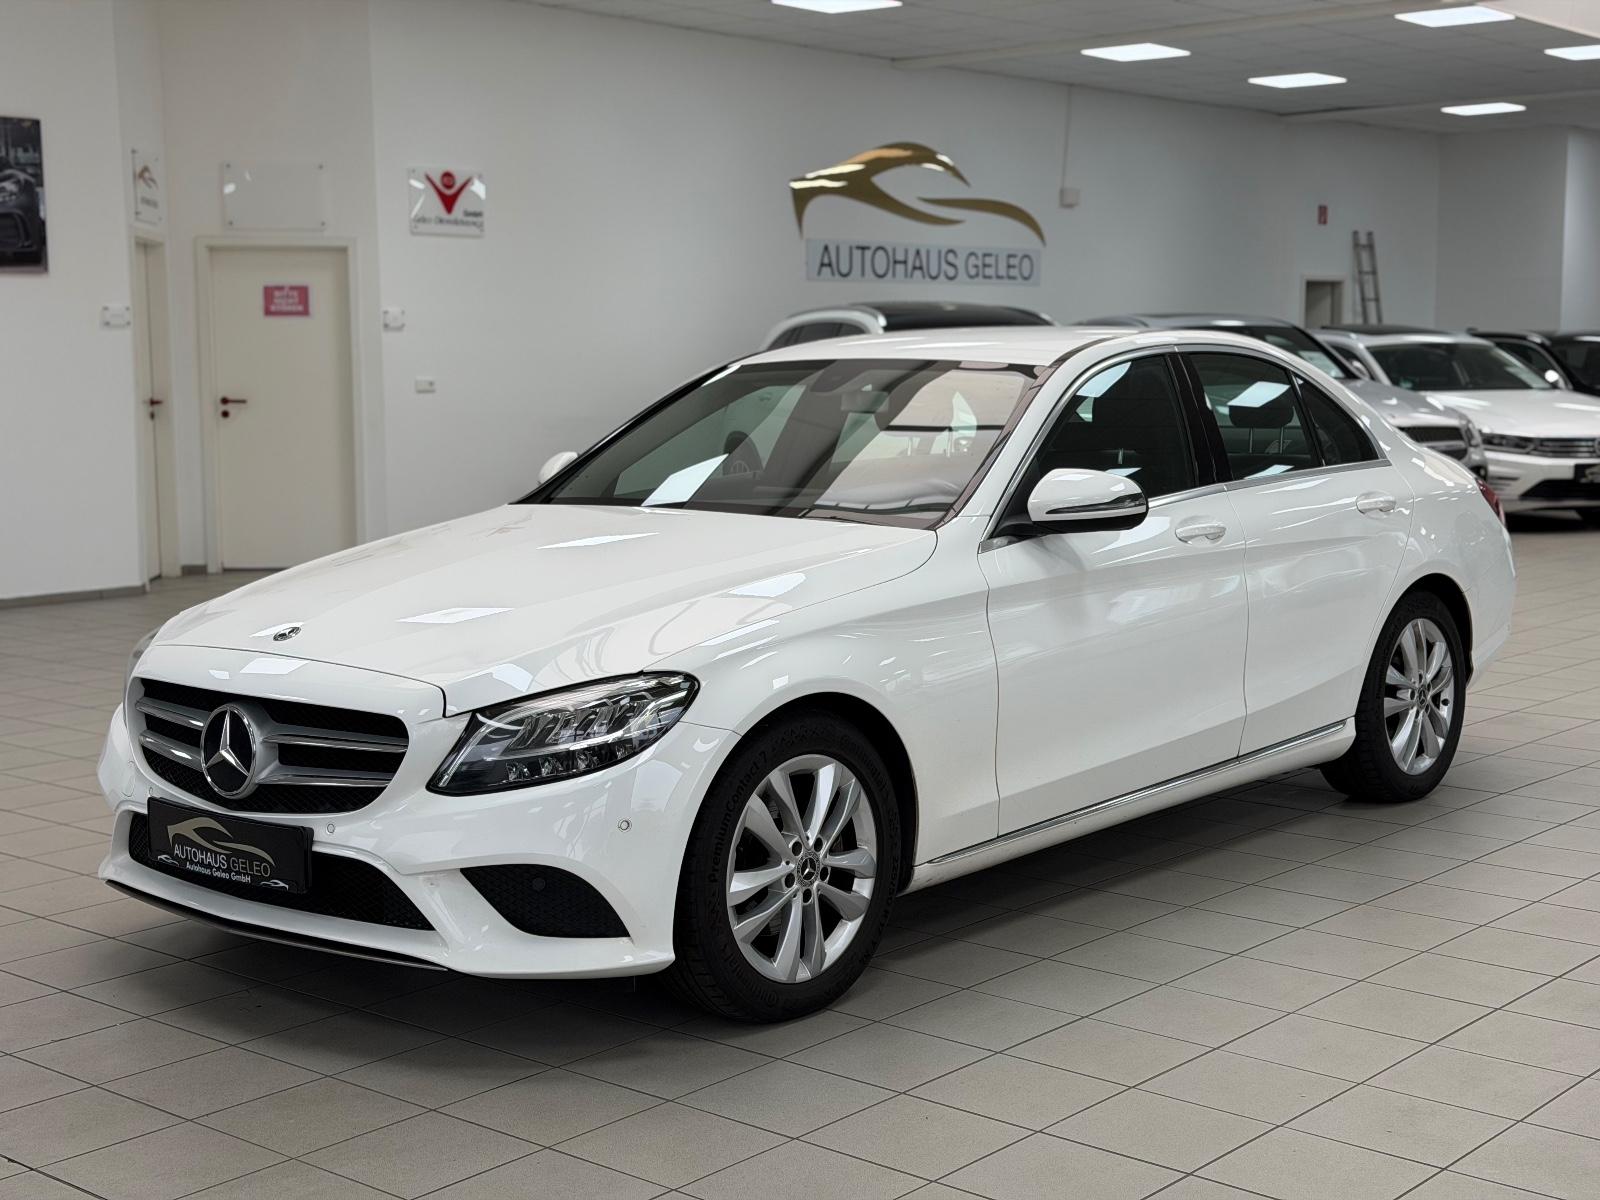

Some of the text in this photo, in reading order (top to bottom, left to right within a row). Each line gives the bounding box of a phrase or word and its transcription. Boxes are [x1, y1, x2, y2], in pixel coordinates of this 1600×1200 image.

[817, 244, 1034, 281] AUTOHAUS GELEO
[174, 844, 270, 877] AUTOHAUS GELEO
[186, 861, 251, 884] Autohaus Geleo GmbH
